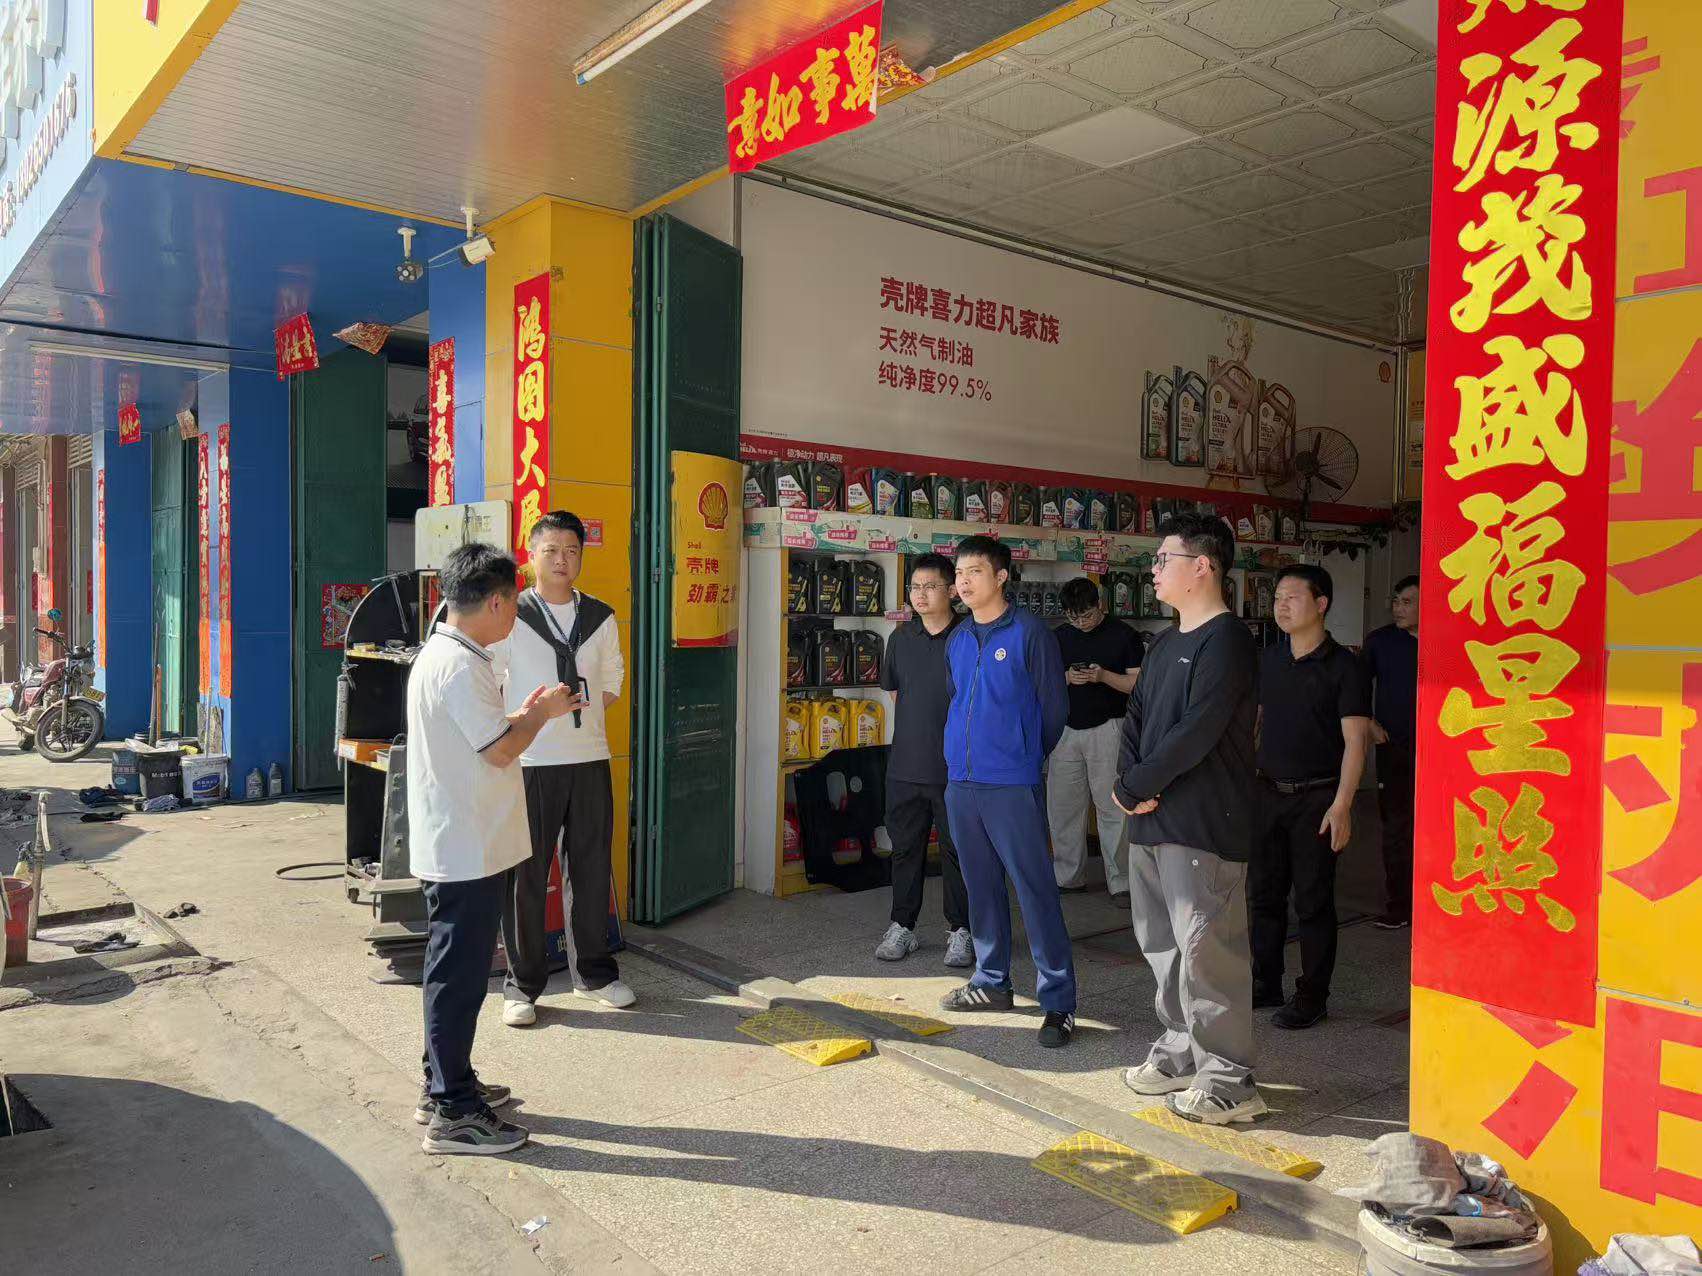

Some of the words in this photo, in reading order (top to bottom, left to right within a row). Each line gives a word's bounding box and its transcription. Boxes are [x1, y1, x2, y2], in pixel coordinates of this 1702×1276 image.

[880, 277, 1060, 344] 壳牌喜力超凡家族
[879, 326, 974, 367] 天然气制油
[878, 360, 992, 401] 纯净度99.5%
[1431, 0, 1602, 933] 源茂盛福星照
[686, 556, 719, 576] 壳牌
